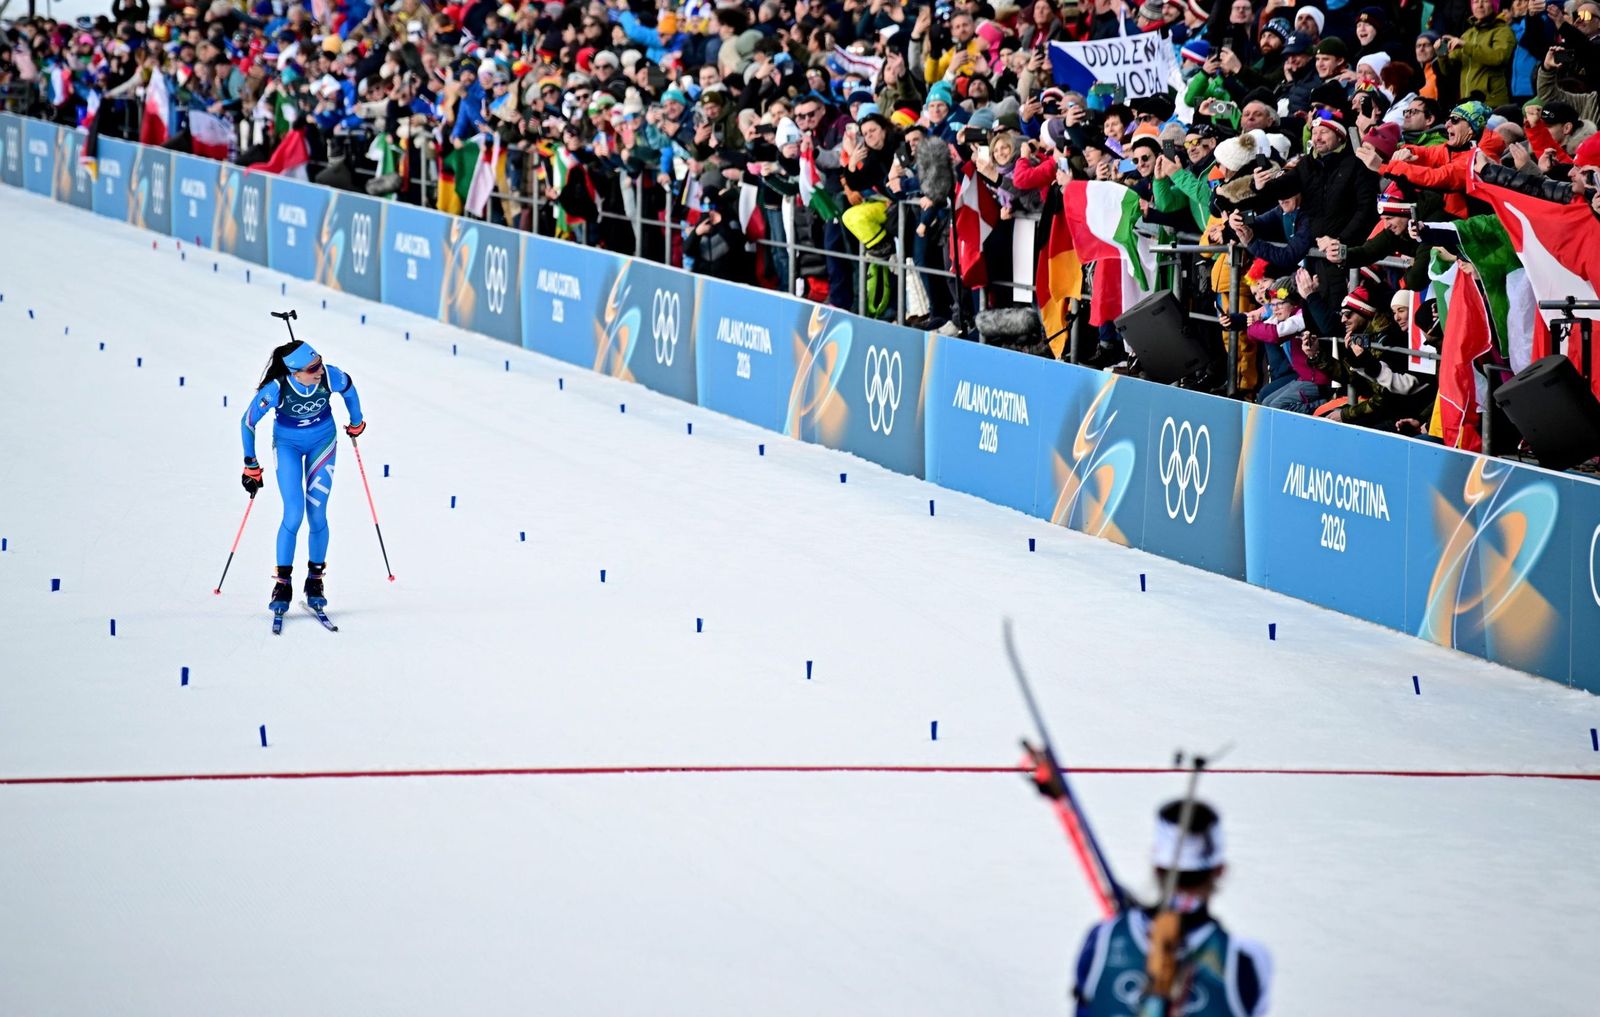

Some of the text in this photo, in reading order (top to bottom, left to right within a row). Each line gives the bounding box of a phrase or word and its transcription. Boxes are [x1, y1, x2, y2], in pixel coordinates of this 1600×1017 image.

[1083, 37, 1160, 67] ODOLEN
[953, 379, 1029, 426] MILANO CORTINA
[979, 420, 998, 453] 2026
[1282, 461, 1390, 522] MILANO CORTINA
[1321, 512, 1346, 552] 2026
